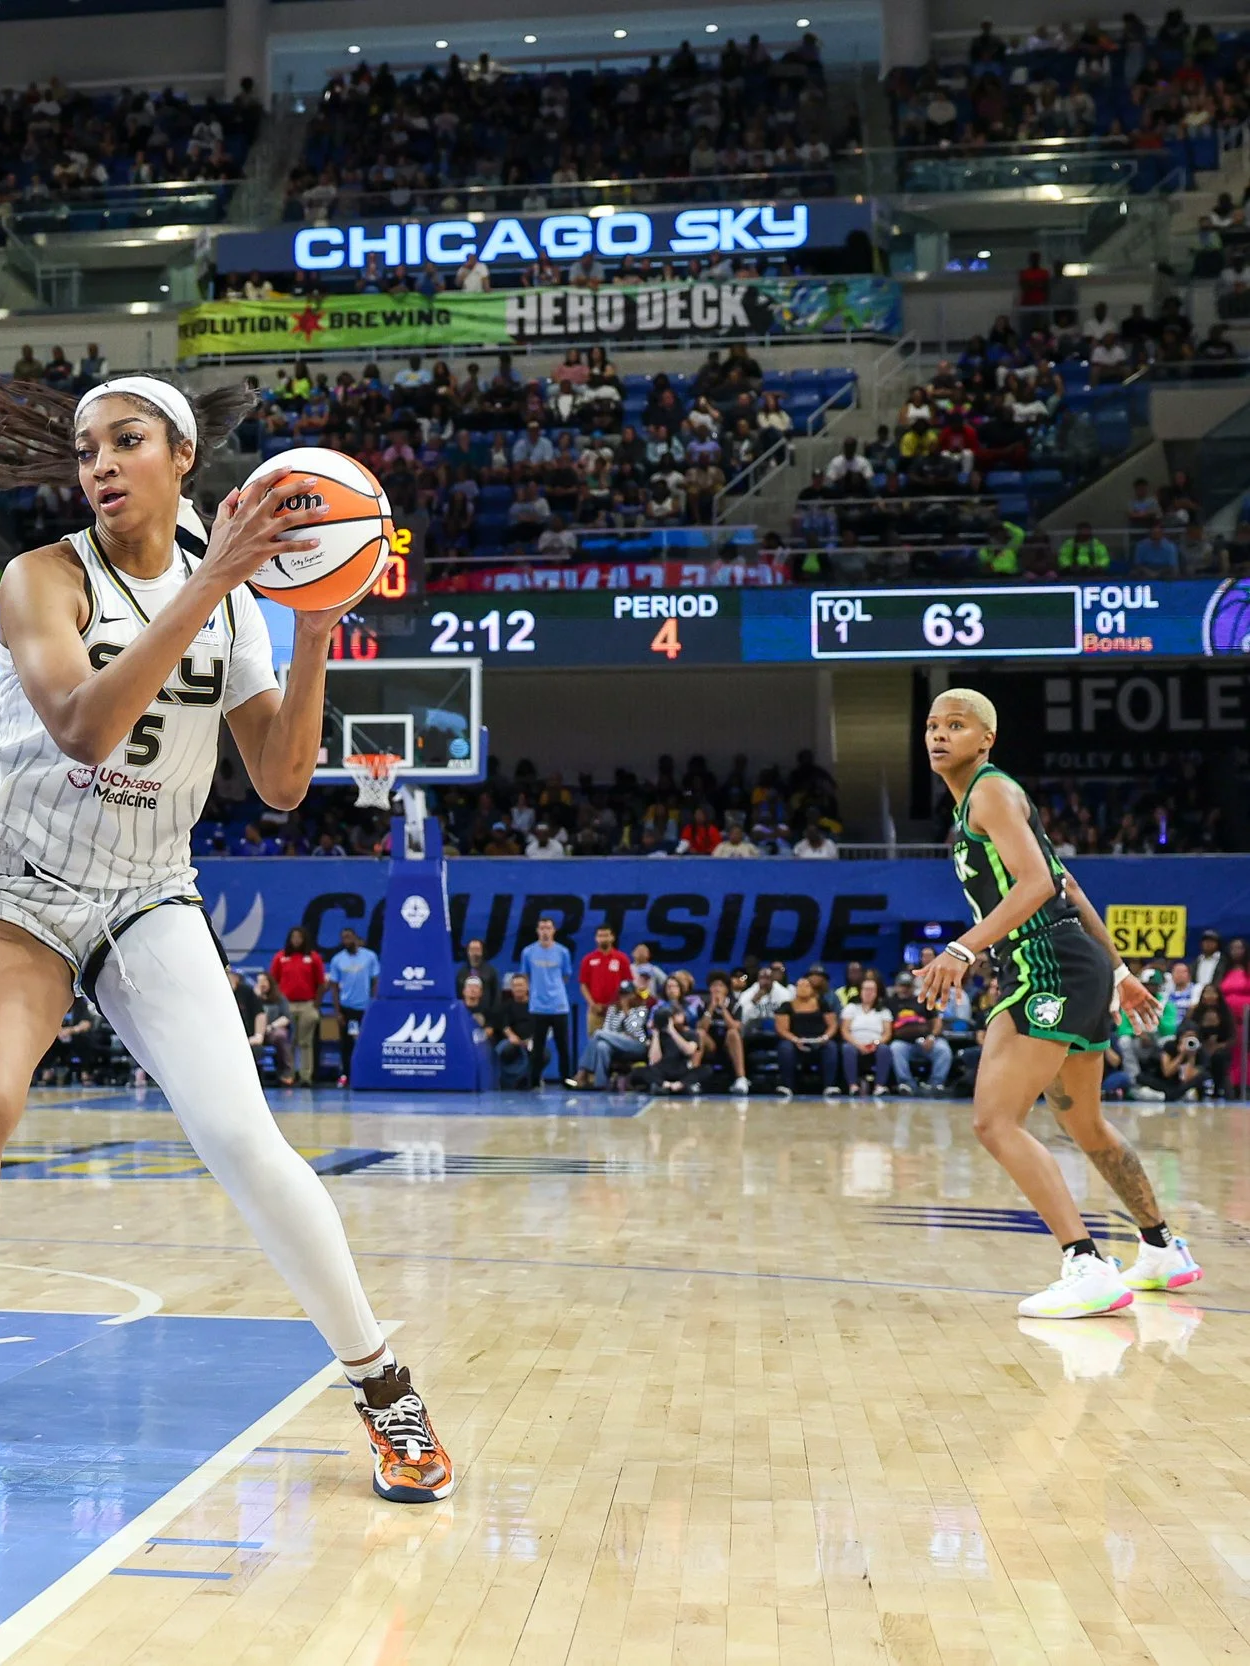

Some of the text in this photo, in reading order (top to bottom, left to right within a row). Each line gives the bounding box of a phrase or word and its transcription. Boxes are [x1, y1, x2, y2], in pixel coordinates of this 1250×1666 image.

[293, 204, 809, 271] CHICAGO SKY
[329, 308, 451, 330] BREWING
[506, 284, 750, 337] HERO DECK
[614, 594, 719, 619] PERIOD
[1083, 585, 1159, 609] FOUL
[817, 599, 873, 623] TOL
[1095, 611, 1126, 634] 01
[430, 610, 536, 653] 2:12
[835, 622, 848, 644] 1
[922, 602, 985, 647] 63
[650, 617, 682, 660] 4
[1083, 633, 1154, 652] Bonus
[1080, 675, 1250, 733] FOLE
[125, 712, 166, 768] 5
[99, 767, 162, 792] UChicago
[93, 783, 158, 810] Medicine
[1113, 909, 1178, 925] LET'S GO
[1114, 928, 1177, 952] SKY
